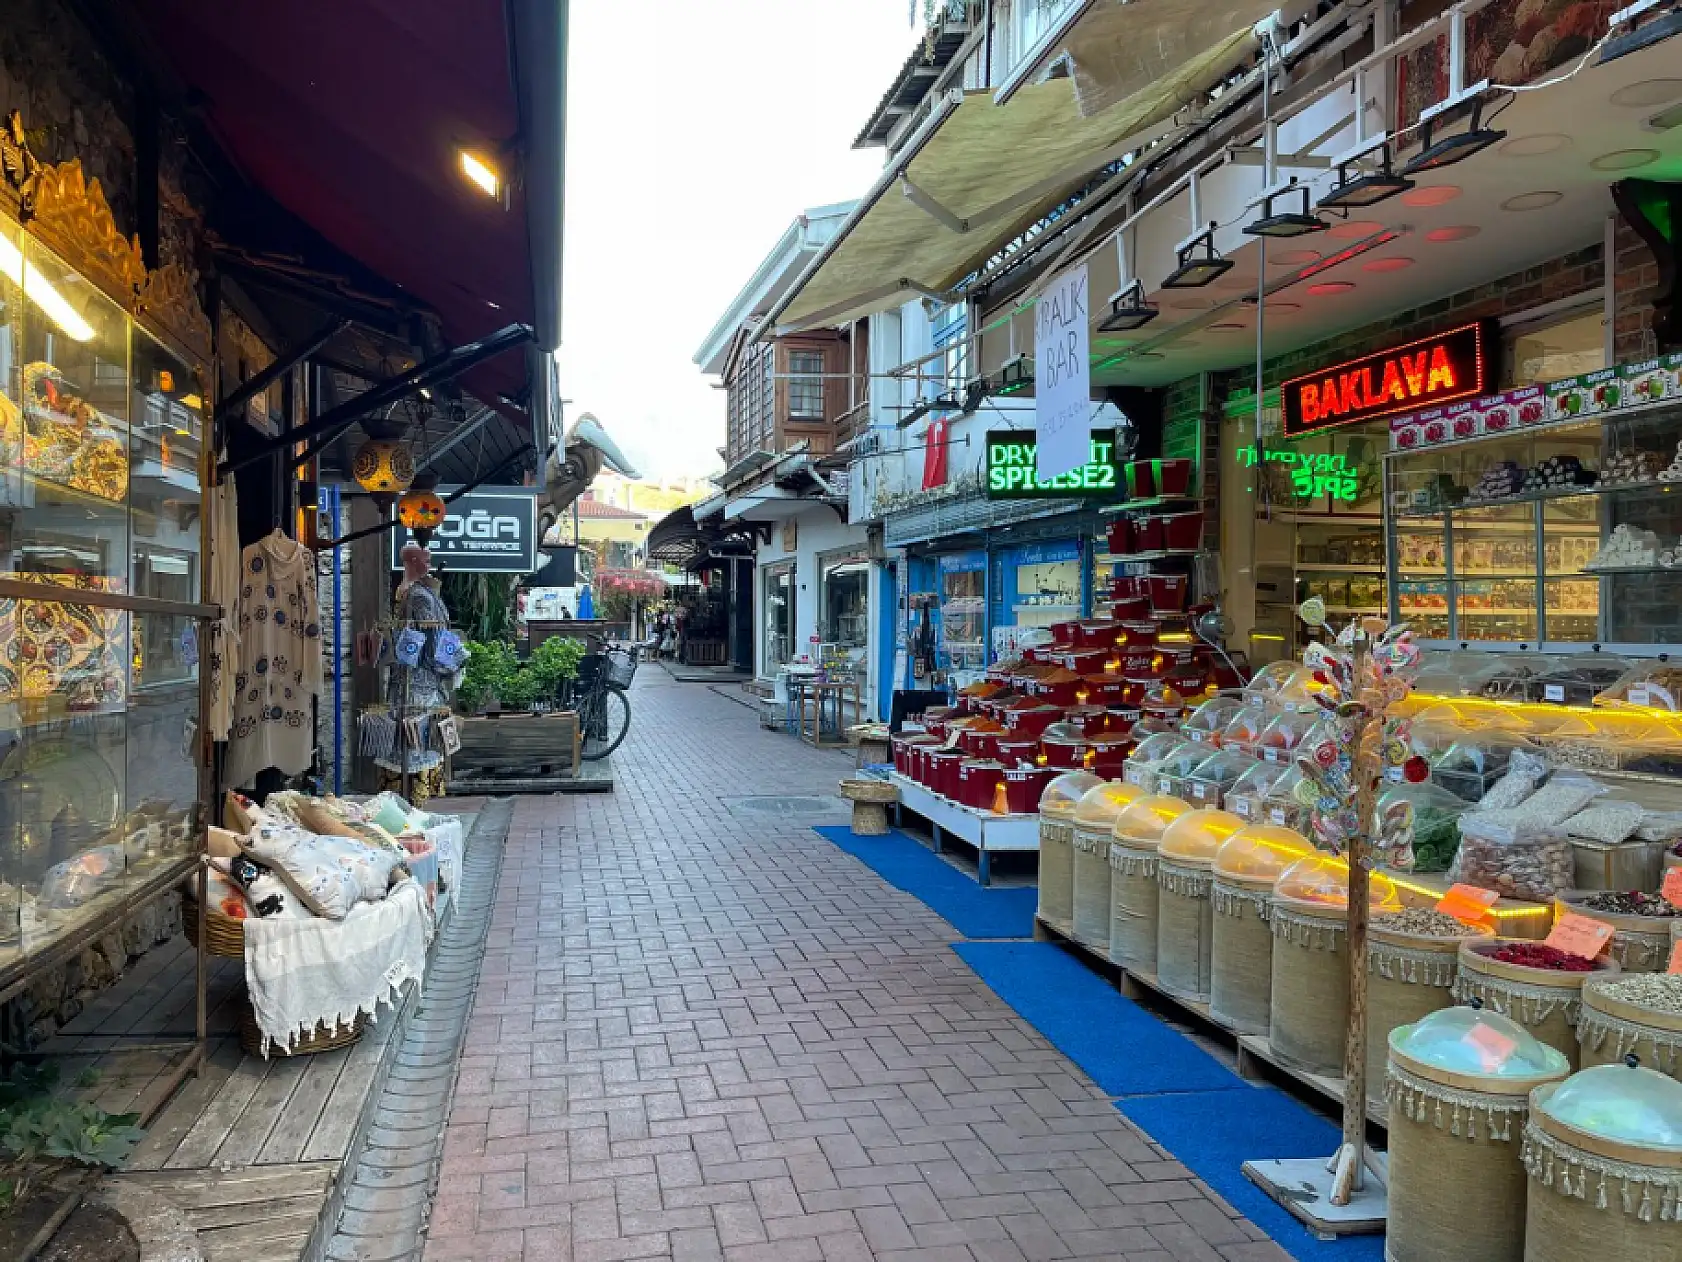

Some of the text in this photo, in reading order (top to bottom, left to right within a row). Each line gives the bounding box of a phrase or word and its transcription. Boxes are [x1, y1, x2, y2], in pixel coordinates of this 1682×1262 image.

[1046, 330, 1079, 389] BAR
[1300, 345, 1457, 424] BAKLAVA
[990, 444, 1037, 465] DRY
[407, 509, 520, 540] OĞA
